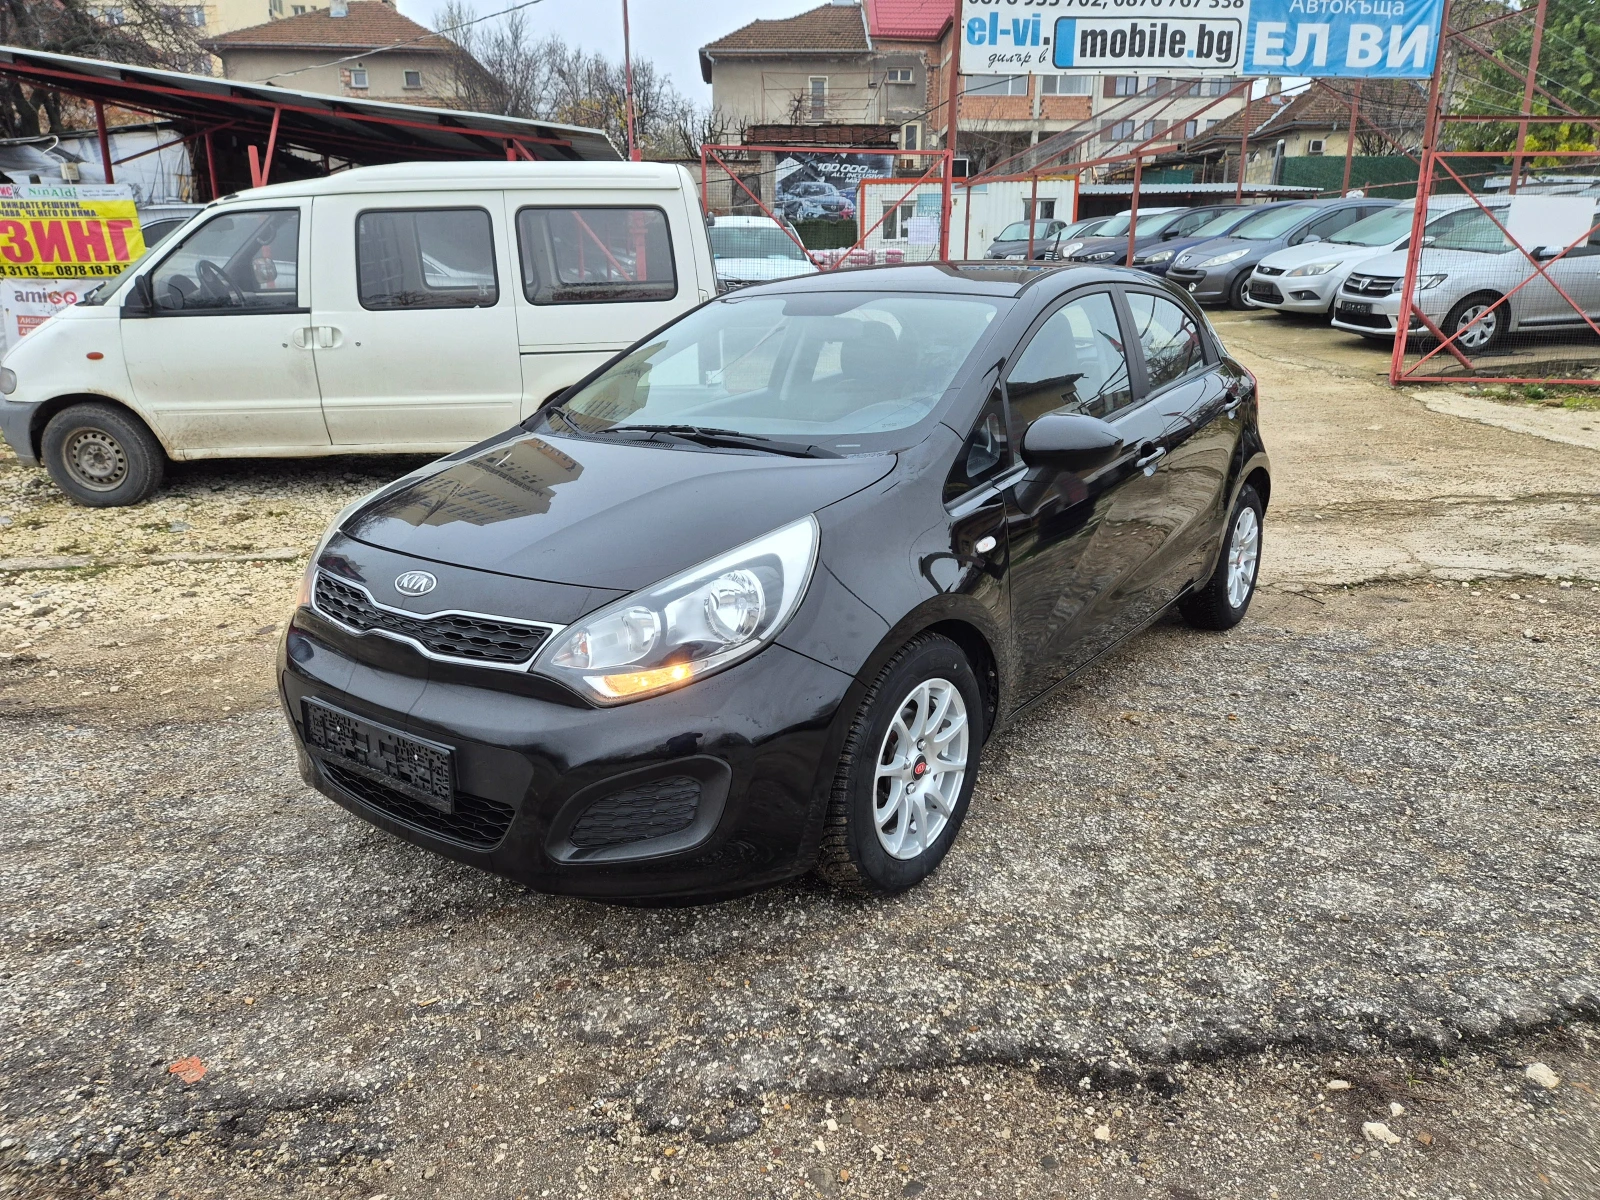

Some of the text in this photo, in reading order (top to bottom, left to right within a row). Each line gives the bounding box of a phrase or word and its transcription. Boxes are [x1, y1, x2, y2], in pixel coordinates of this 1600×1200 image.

[1288, 0, 1405, 19] Автокъща
[1079, 23, 1234, 63] mobile.bg
[1252, 21, 1429, 68] ЕЛ ВИ
[987, 47, 1047, 68] дилър в
[817, 163, 840, 172] 100
[840, 164, 869, 173] 000
[1, 201, 41, 210] ВИЖДАТЕ
[26, 209, 37, 217] ЧЕ
[38, 209, 59, 217] НЕГО
[60, 209, 70, 217] ГО
[71, 209, 100, 217] НЯМА.
[25, 265, 39, 276] 13
[56, 265, 87, 276] 0878
[89, 264, 104, 275] 18
[105, 264, 122, 275] 78
[19, 316, 50, 325] ЛИЗИН
[399, 574, 430, 592] KIA
